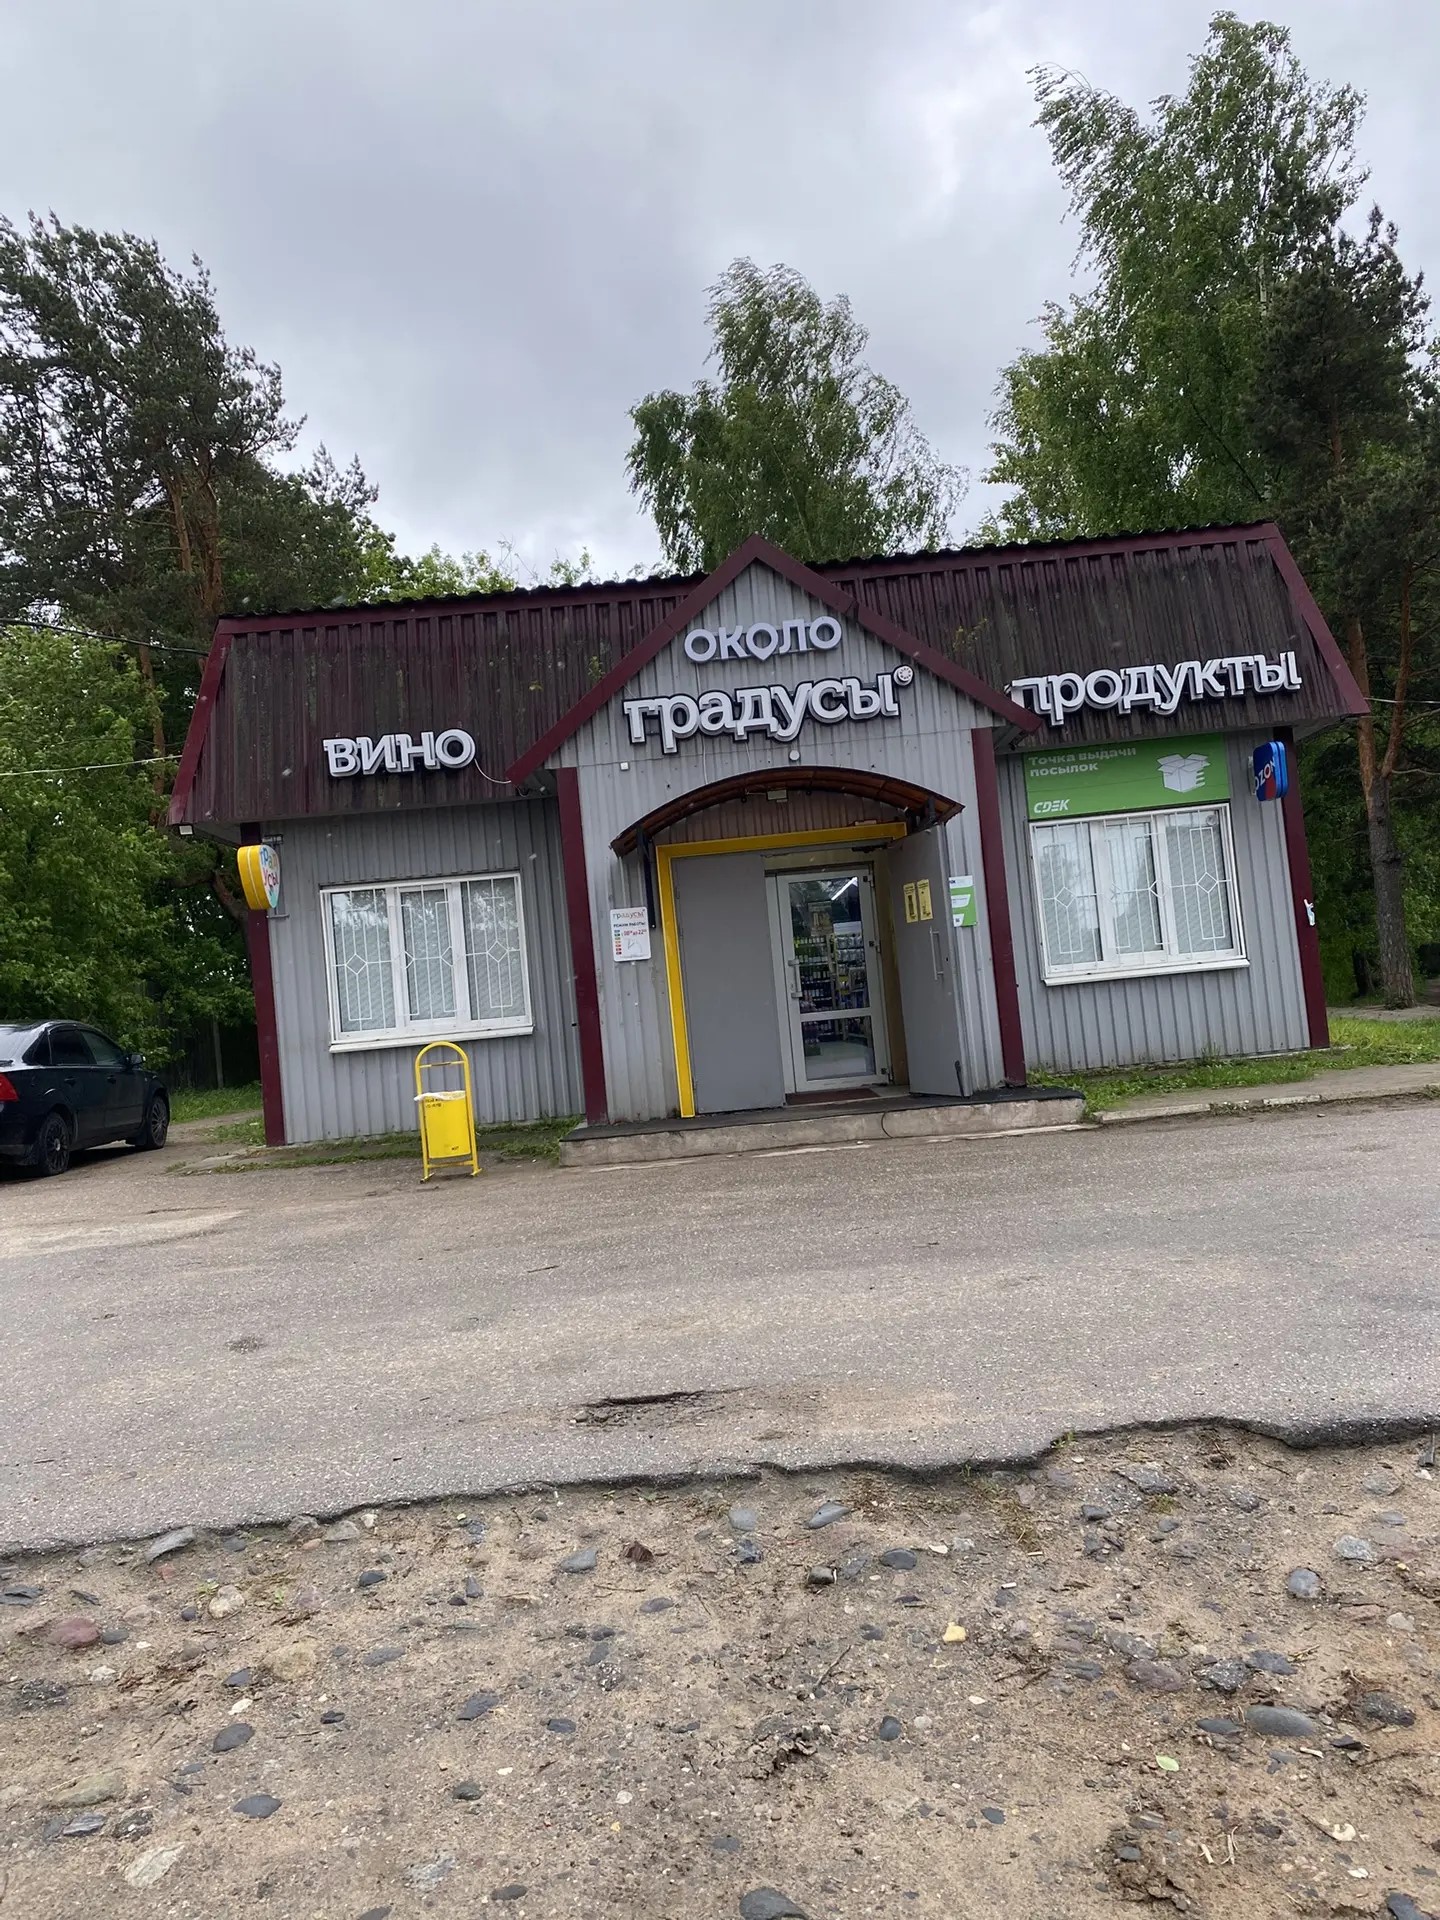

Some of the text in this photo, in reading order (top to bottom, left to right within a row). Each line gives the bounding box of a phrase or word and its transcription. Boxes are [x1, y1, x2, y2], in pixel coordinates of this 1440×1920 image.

[1003, 651, 1302, 726] продукты
[1028, 747, 1137, 767] Точка выдачи
[1030, 762, 1099, 777] посылок
